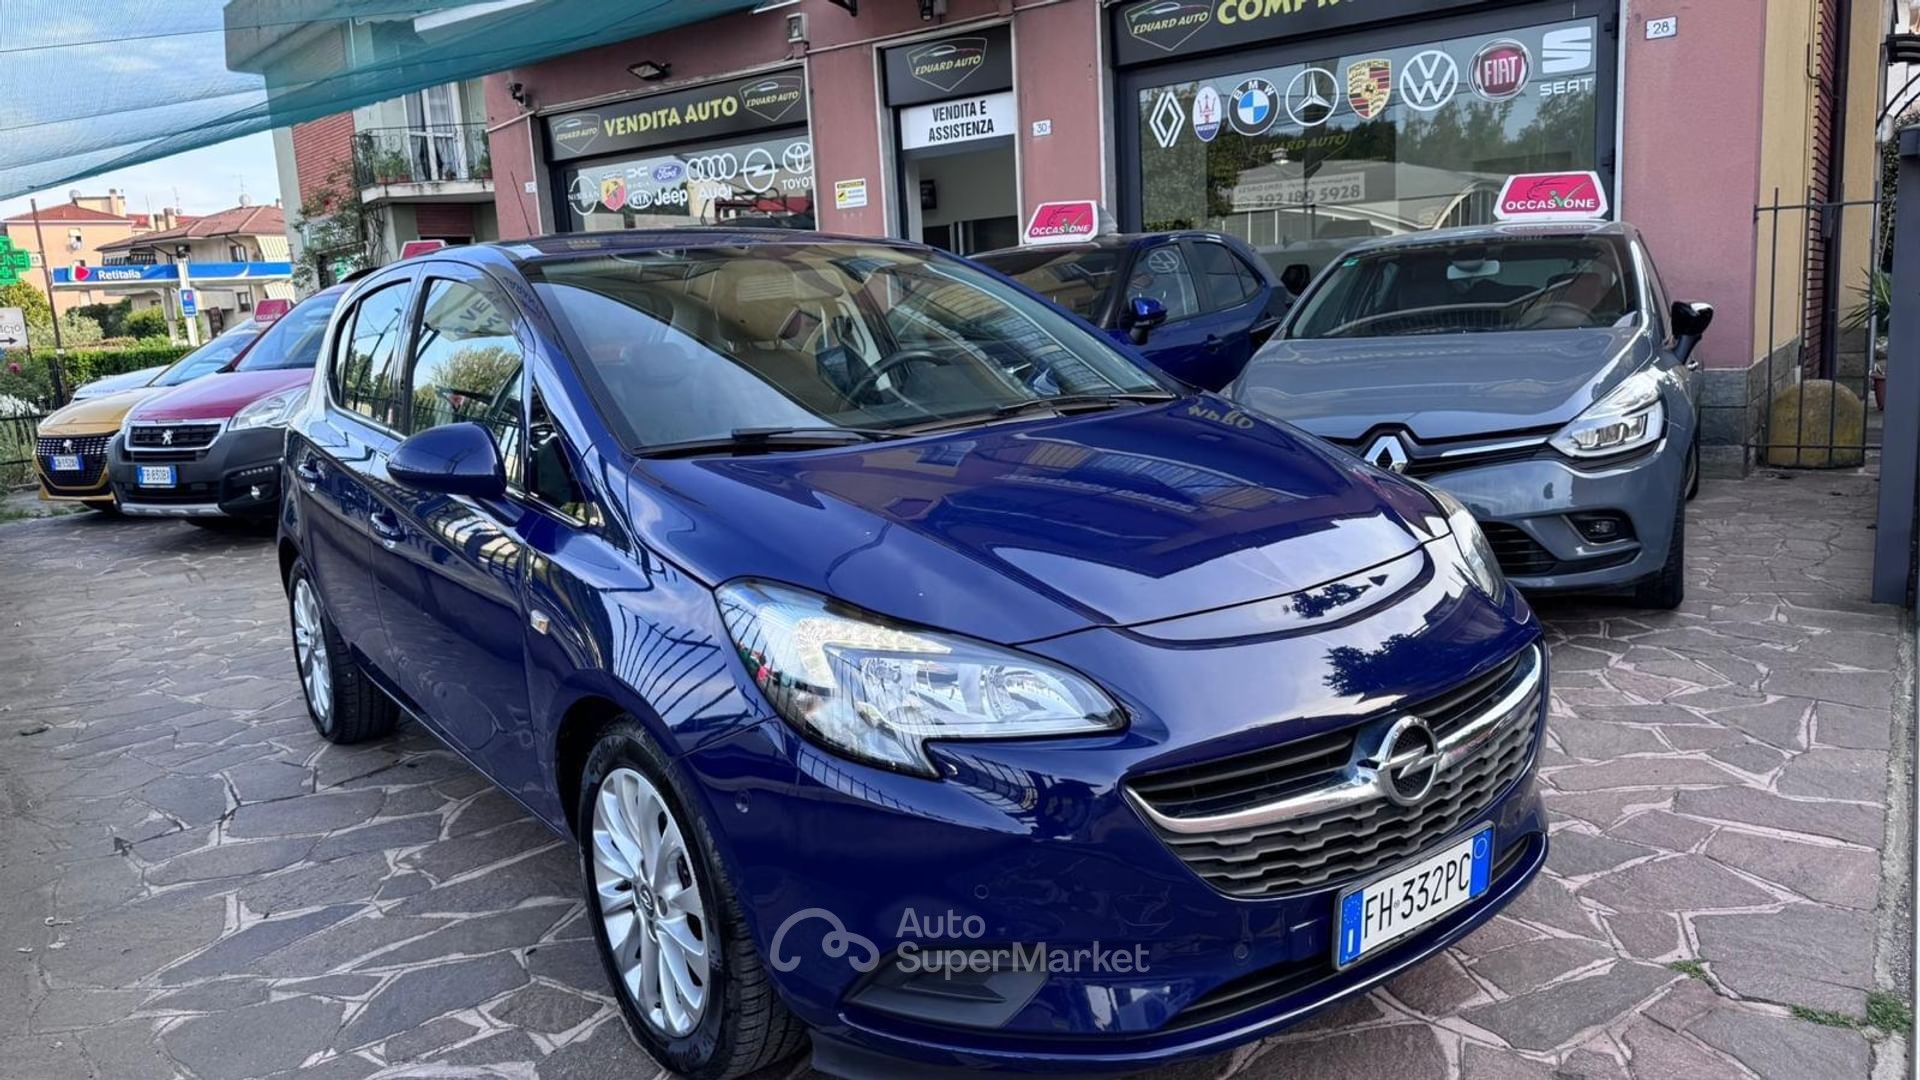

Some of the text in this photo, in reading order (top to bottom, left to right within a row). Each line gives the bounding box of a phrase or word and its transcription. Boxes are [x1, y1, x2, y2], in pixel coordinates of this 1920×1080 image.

[1133, 11, 1208, 35] EDUARD AUTO
[1653, 21, 1670, 35] 28
[914, 54, 981, 76] EDUARD AUTO
[1483, 55, 1518, 87] FIAT
[1540, 77, 1592, 97] SEAT
[746, 90, 799, 107] EDUARD AUTO
[603, 96, 738, 137] VENDITA AUTO
[932, 99, 987, 123] VENDITA E
[556, 127, 598, 142] EDUARD AUTO
[928, 118, 994, 142] ASSISTENZA
[1036, 122, 1047, 134] 30
[1308, 134, 1347, 148] AUTO
[632, 194, 650, 205] KIA
[654, 188, 688, 207] Jeep
[698, 185, 732, 201] AUDI
[1320, 184, 1360, 201] 5928
[98, 269, 141, 280] Retitalia
